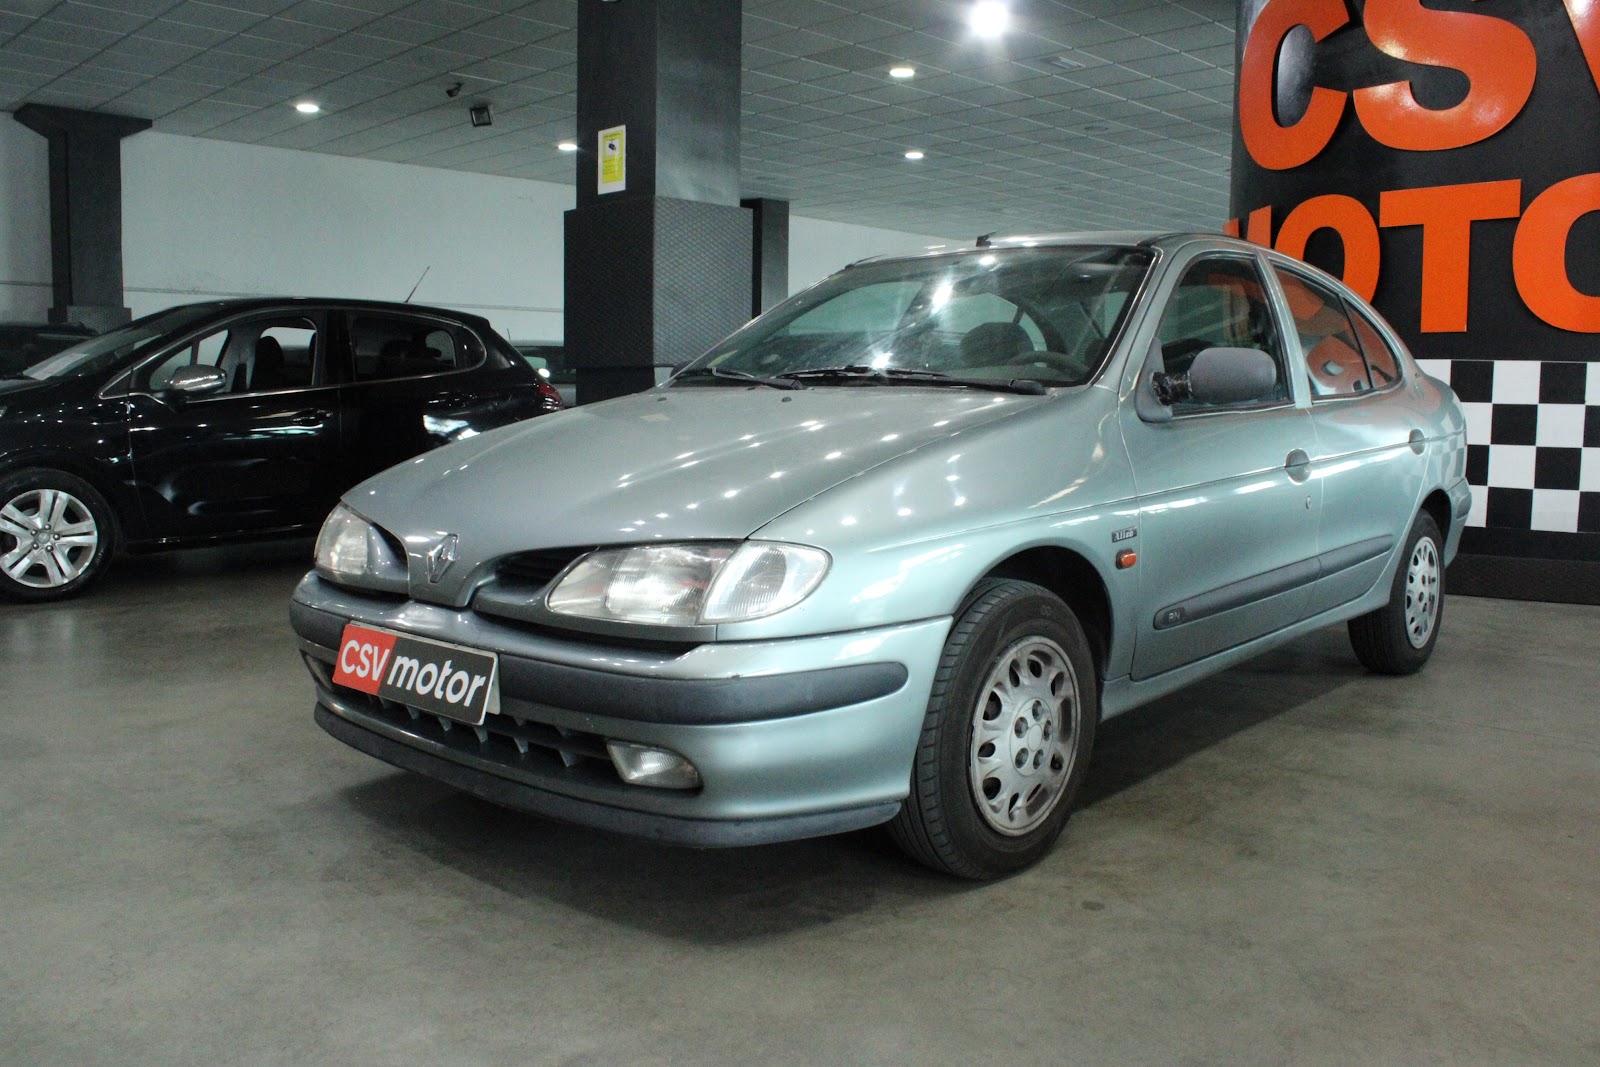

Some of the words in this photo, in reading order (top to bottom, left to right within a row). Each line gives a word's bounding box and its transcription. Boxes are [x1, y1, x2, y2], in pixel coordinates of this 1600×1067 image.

[1239, 0, 1600, 170] CS
[1223, 172, 1600, 333] OTO
[341, 640, 390, 681] CSV
[387, 655, 486, 707] motor
